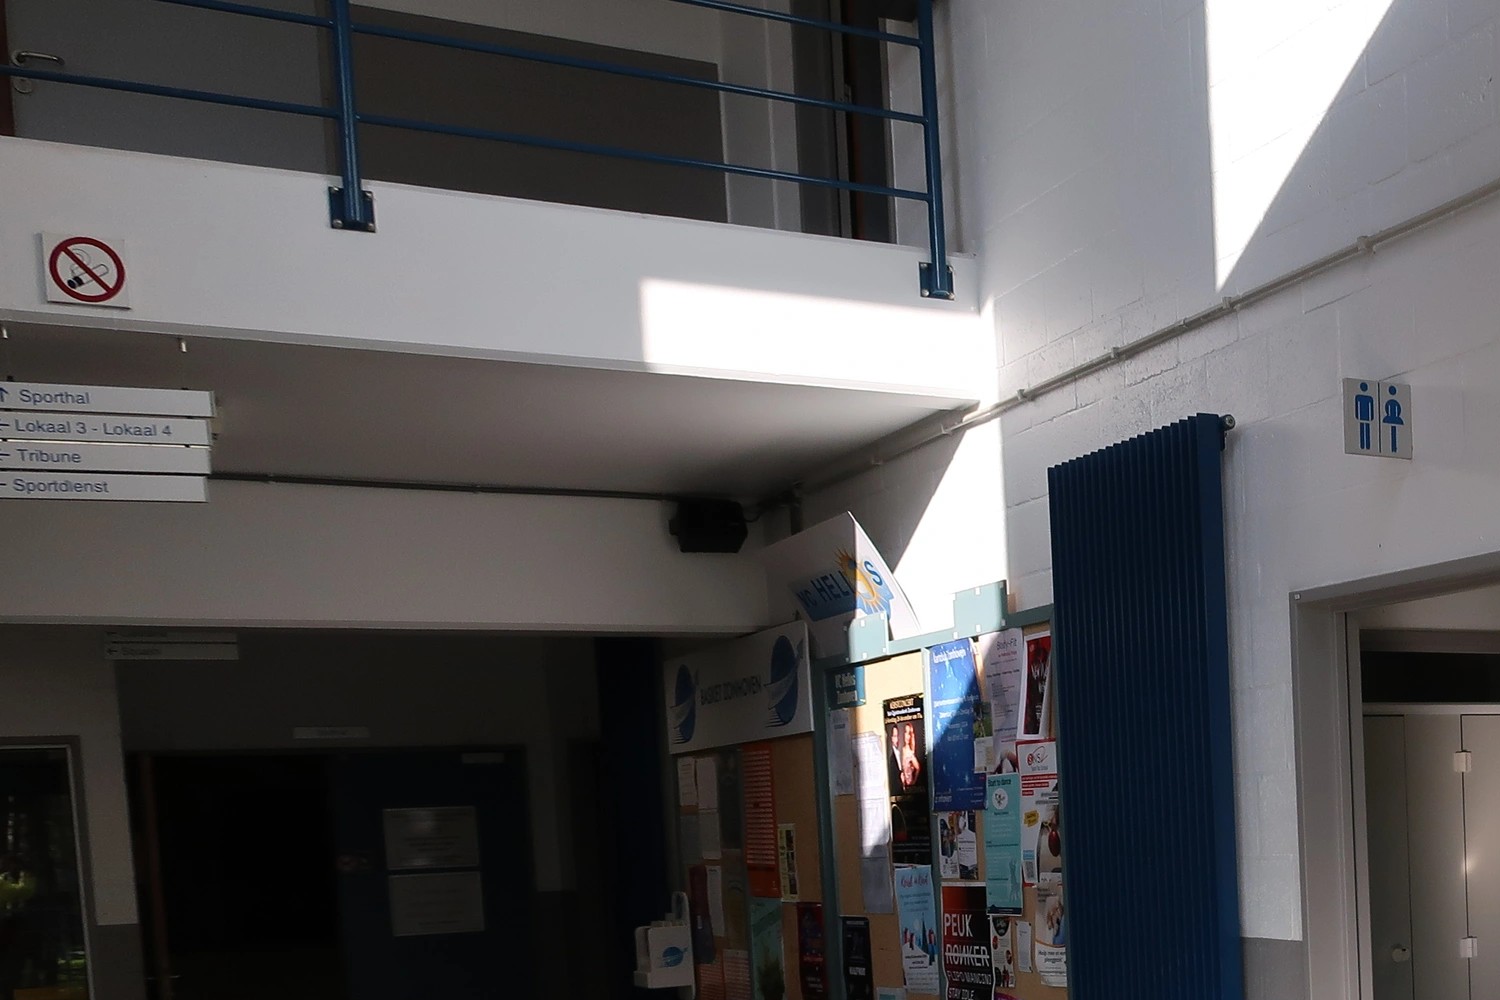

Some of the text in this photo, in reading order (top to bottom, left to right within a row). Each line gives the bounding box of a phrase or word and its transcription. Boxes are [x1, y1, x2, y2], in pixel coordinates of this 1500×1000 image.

[19, 389, 90, 405] Sporthal
[15, 419, 71, 434] Lokaal
[76, 422, 87, 434] 3
[103, 422, 157, 437] Lokaal
[162, 425, 172, 436] 4
[16, 448, 81, 464] Tribune
[13, 478, 109, 495] Sportdienst
[944, 913, 973, 938] PEUK
